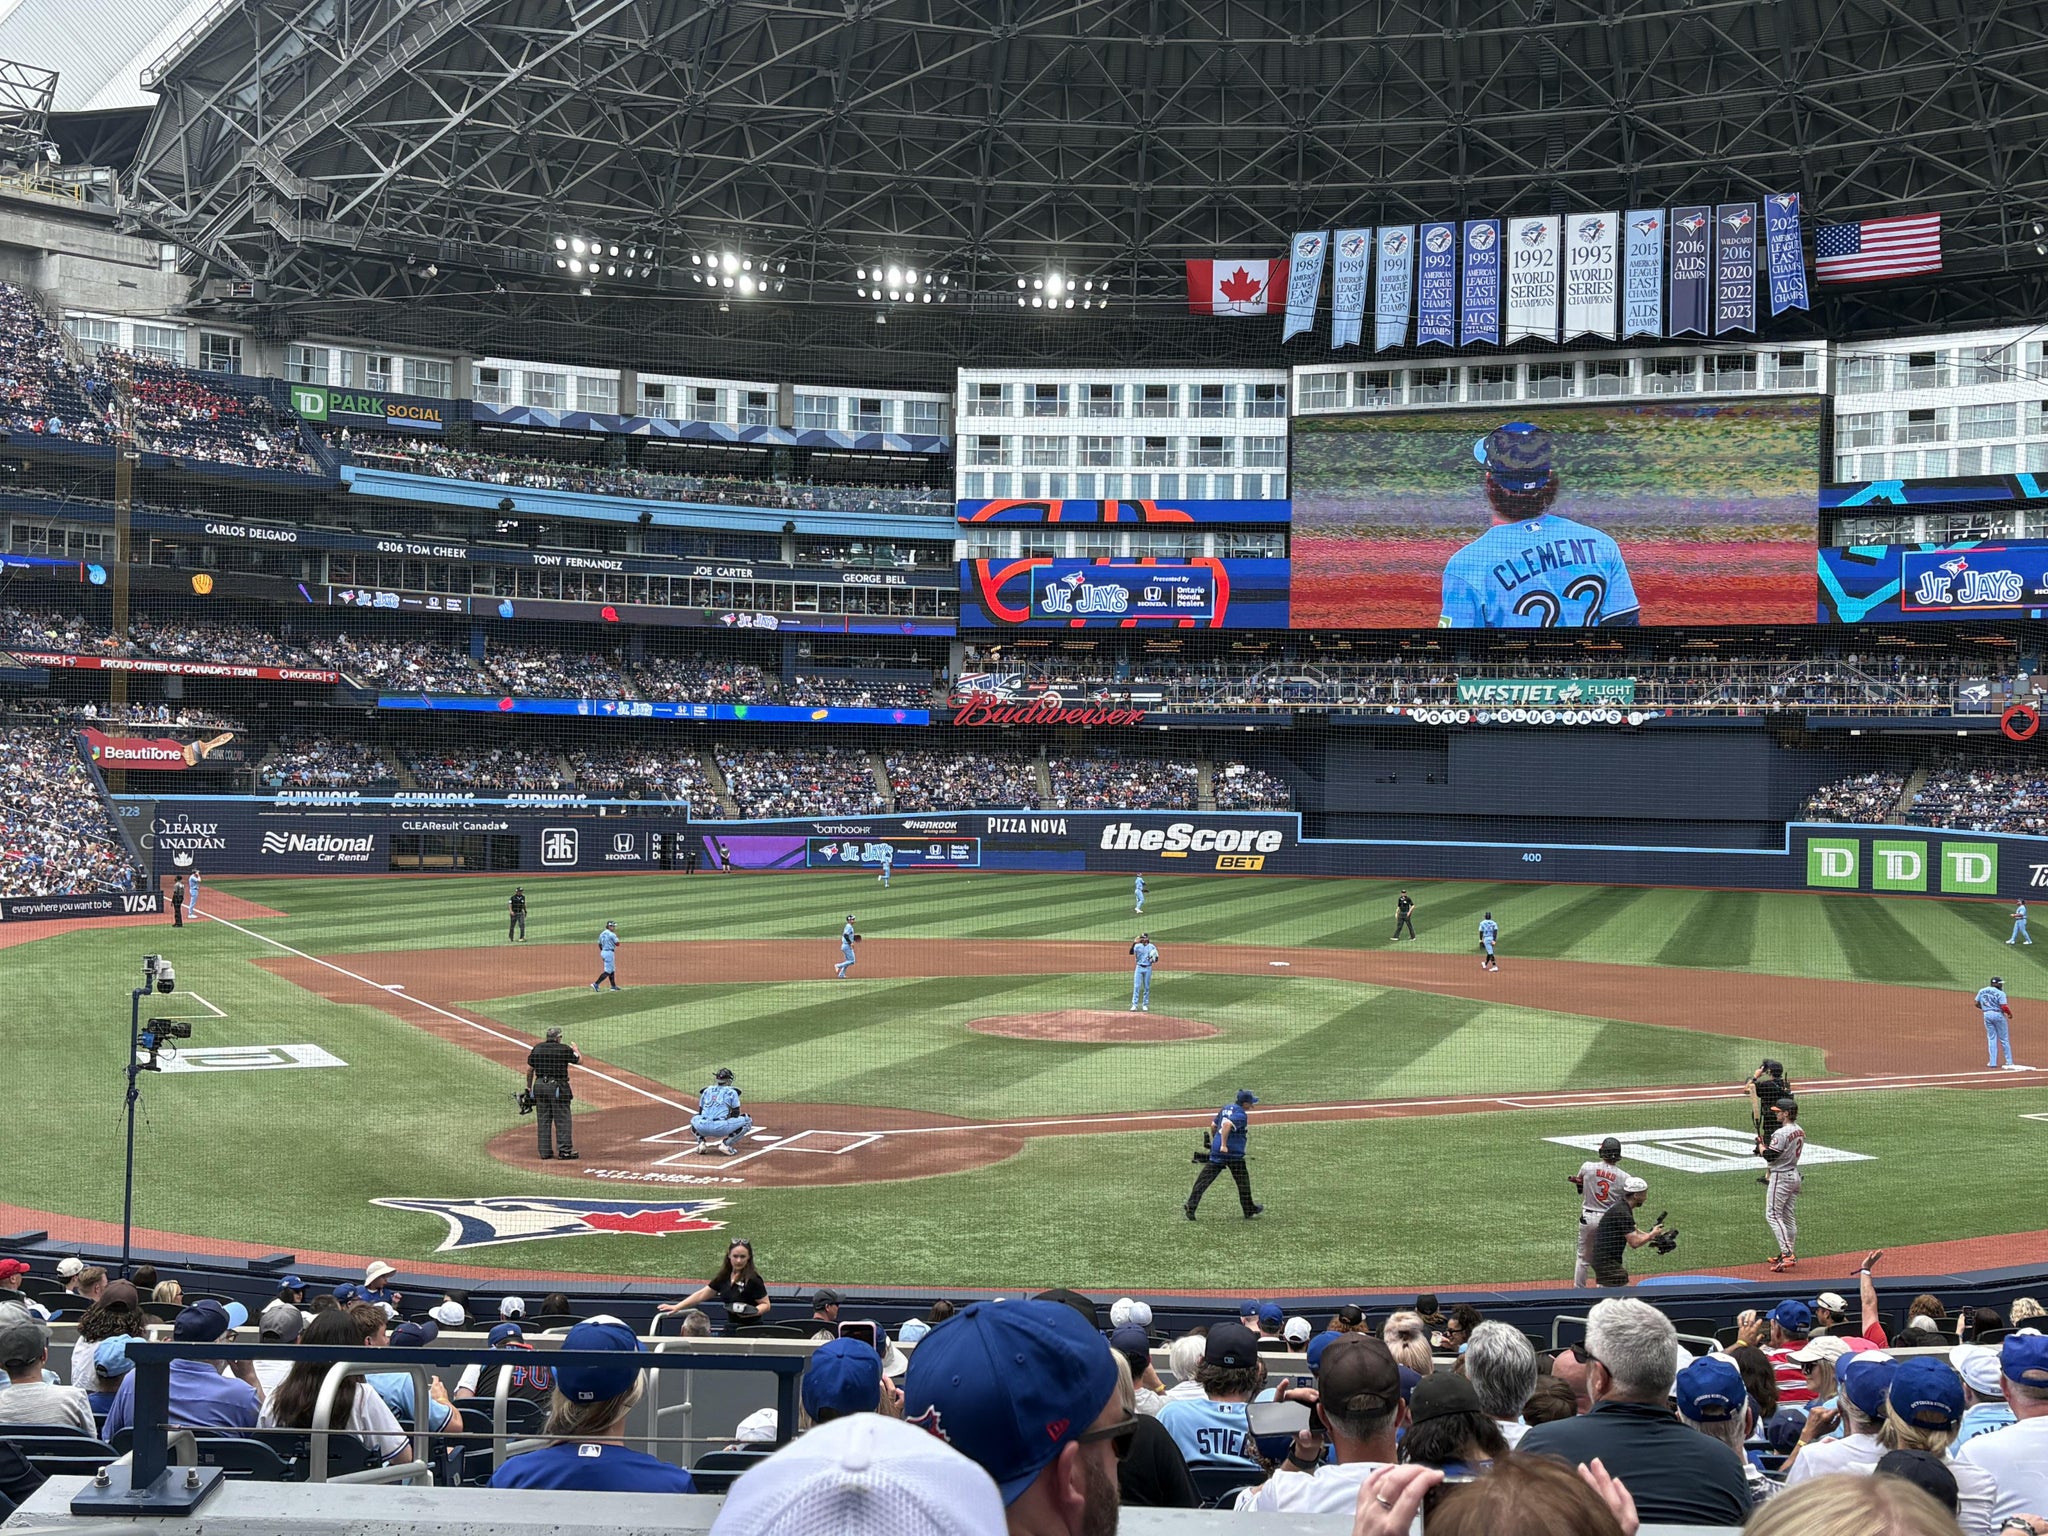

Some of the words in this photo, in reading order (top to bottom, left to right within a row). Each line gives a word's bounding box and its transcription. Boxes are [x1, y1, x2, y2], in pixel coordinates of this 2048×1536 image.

[1770, 215, 1798, 231] 2025
[1630, 242, 1659, 256] 2015
[1676, 240, 1705, 254] 2016
[1721, 246, 1751, 260] 2016
[1771, 240, 1799, 253] LEAGUE
[1425, 255, 1452, 268] 1992
[1469, 252, 1496, 265] 1993
[1513, 249, 1553, 268] 1992
[1571, 245, 1612, 265] 1993
[1772, 250, 1799, 265] EAST
[1340, 260, 1364, 272] 1989
[1384, 259, 1407, 271] 1991
[1629, 260, 1659, 268] AMERICAN
[1675, 257, 1706, 271] ALDS
[1772, 262, 1801, 274] CHAMPS
[1381, 274, 1408, 282] AMERICAN
[1466, 269, 1496, 277] AMERICAN
[1512, 271, 1554, 285] WORLD
[1569, 268, 1613, 282] WORLD
[1629, 267, 1659, 277] LEAGUE
[1674, 270, 1706, 280] CHAMPS
[1720, 266, 1752, 280] 2020
[1381, 282, 1408, 293] LEAGUE
[1423, 279, 1452, 288] LEAGUE
[1466, 276, 1496, 286] LEAGUE
[1629, 277, 1659, 290] EAST
[1775, 277, 1803, 294] ALCS
[1337, 283, 1364, 293] LEAGUE
[1423, 288, 1452, 300] EAST
[1466, 286, 1496, 298] EAST
[1511, 284, 1554, 299] SERIES
[1568, 282, 1613, 296] SERIES
[1628, 289, 1658, 299] CHAMPS
[1720, 285, 1752, 299] 2022
[1337, 292, 1361, 304] EAST
[1381, 291, 1408, 304] EAST
[1422, 299, 1452, 308] CHAMPS
[1465, 297, 1496, 306] CHAMPS
[1511, 298, 1554, 308] CHAMPIONS
[1568, 295, 1613, 306] CHAMPIONS
[1774, 291, 1804, 303] CHAMPS
[1380, 304, 1408, 313] CHAMPS
[1629, 304, 1658, 318] ALDS
[1720, 305, 1752, 319] 2023
[1422, 314, 1451, 327] ALCS
[1627, 318, 1658, 327] CHAMPS
[1421, 326, 1451, 336] CHAMPS
[294, 392, 324, 414] TD
[329, 393, 386, 415] PARK
[387, 404, 443, 422] SOCIAL
[205, 523, 246, 538] CARLOS
[249, 527, 297, 543] DELGADO
[377, 541, 404, 553] 4306
[406, 544, 431, 556] TOM
[433, 546, 467, 559] CHEEK
[533, 554, 562, 566] TONY
[565, 557, 623, 571] FERNANDEZ
[1493, 538, 1597, 592] CLEMENT
[693, 566, 713, 576] JOE
[716, 566, 753, 578] CARTER
[842, 573, 882, 583] GEORGE
[885, 575, 907, 584] BELL
[1177, 586, 1205, 594] Ontario
[1915, 571, 1953, 605] Jr.
[1957, 570, 2024, 604] JAYS
[1042, 583, 1073, 613] Jr.
[1076, 584, 1129, 613] JAYS
[1177, 593, 1201, 601] Honda
[1177, 600, 1205, 608] Dealers
[100, 659, 133, 669] PROUD
[169, 663, 183, 672] OF
[183, 665, 231, 676] CANADA'S
[232, 668, 258, 677] TEAM
[289, 671, 323, 681] ROGERS
[1460, 685, 1557, 702] WESTJET
[1588, 685, 1632, 695] FLIGHT
[946, 691, 1146, 727] Budweiser
[1415, 708, 1468, 724] VOTE
[1498, 709, 1555, 724] BLUE
[1563, 709, 1621, 724] JAYS
[104, 746, 182, 760] BeautiTone
[118, 806, 141, 817] 328
[150, 818, 218, 838] CLEARLY
[402, 821, 461, 831] CLEAResult
[463, 821, 499, 831] Canada
[987, 816, 1027, 835] PIZZA
[1031, 817, 1067, 836] NOVA
[140, 833, 226, 850] CANADIAN
[1099, 822, 1284, 853] theScore
[317, 853, 335, 862] Car
[338, 853, 369, 862] Rental
[1219, 857, 1260, 868] BET
[1522, 853, 1542, 862] 400
[1813, 847, 1854, 877] TD
[1878, 850, 1921, 881] TD
[1947, 852, 1992, 883] TD
[12, 902, 58, 914] everywhere
[58, 903, 74, 913] you
[74, 902, 93, 911] want
[93, 901, 102, 910] to
[102, 900, 113, 909] be
[120, 895, 157, 912] VISA
[1594, 1180, 1610, 1202] 3
